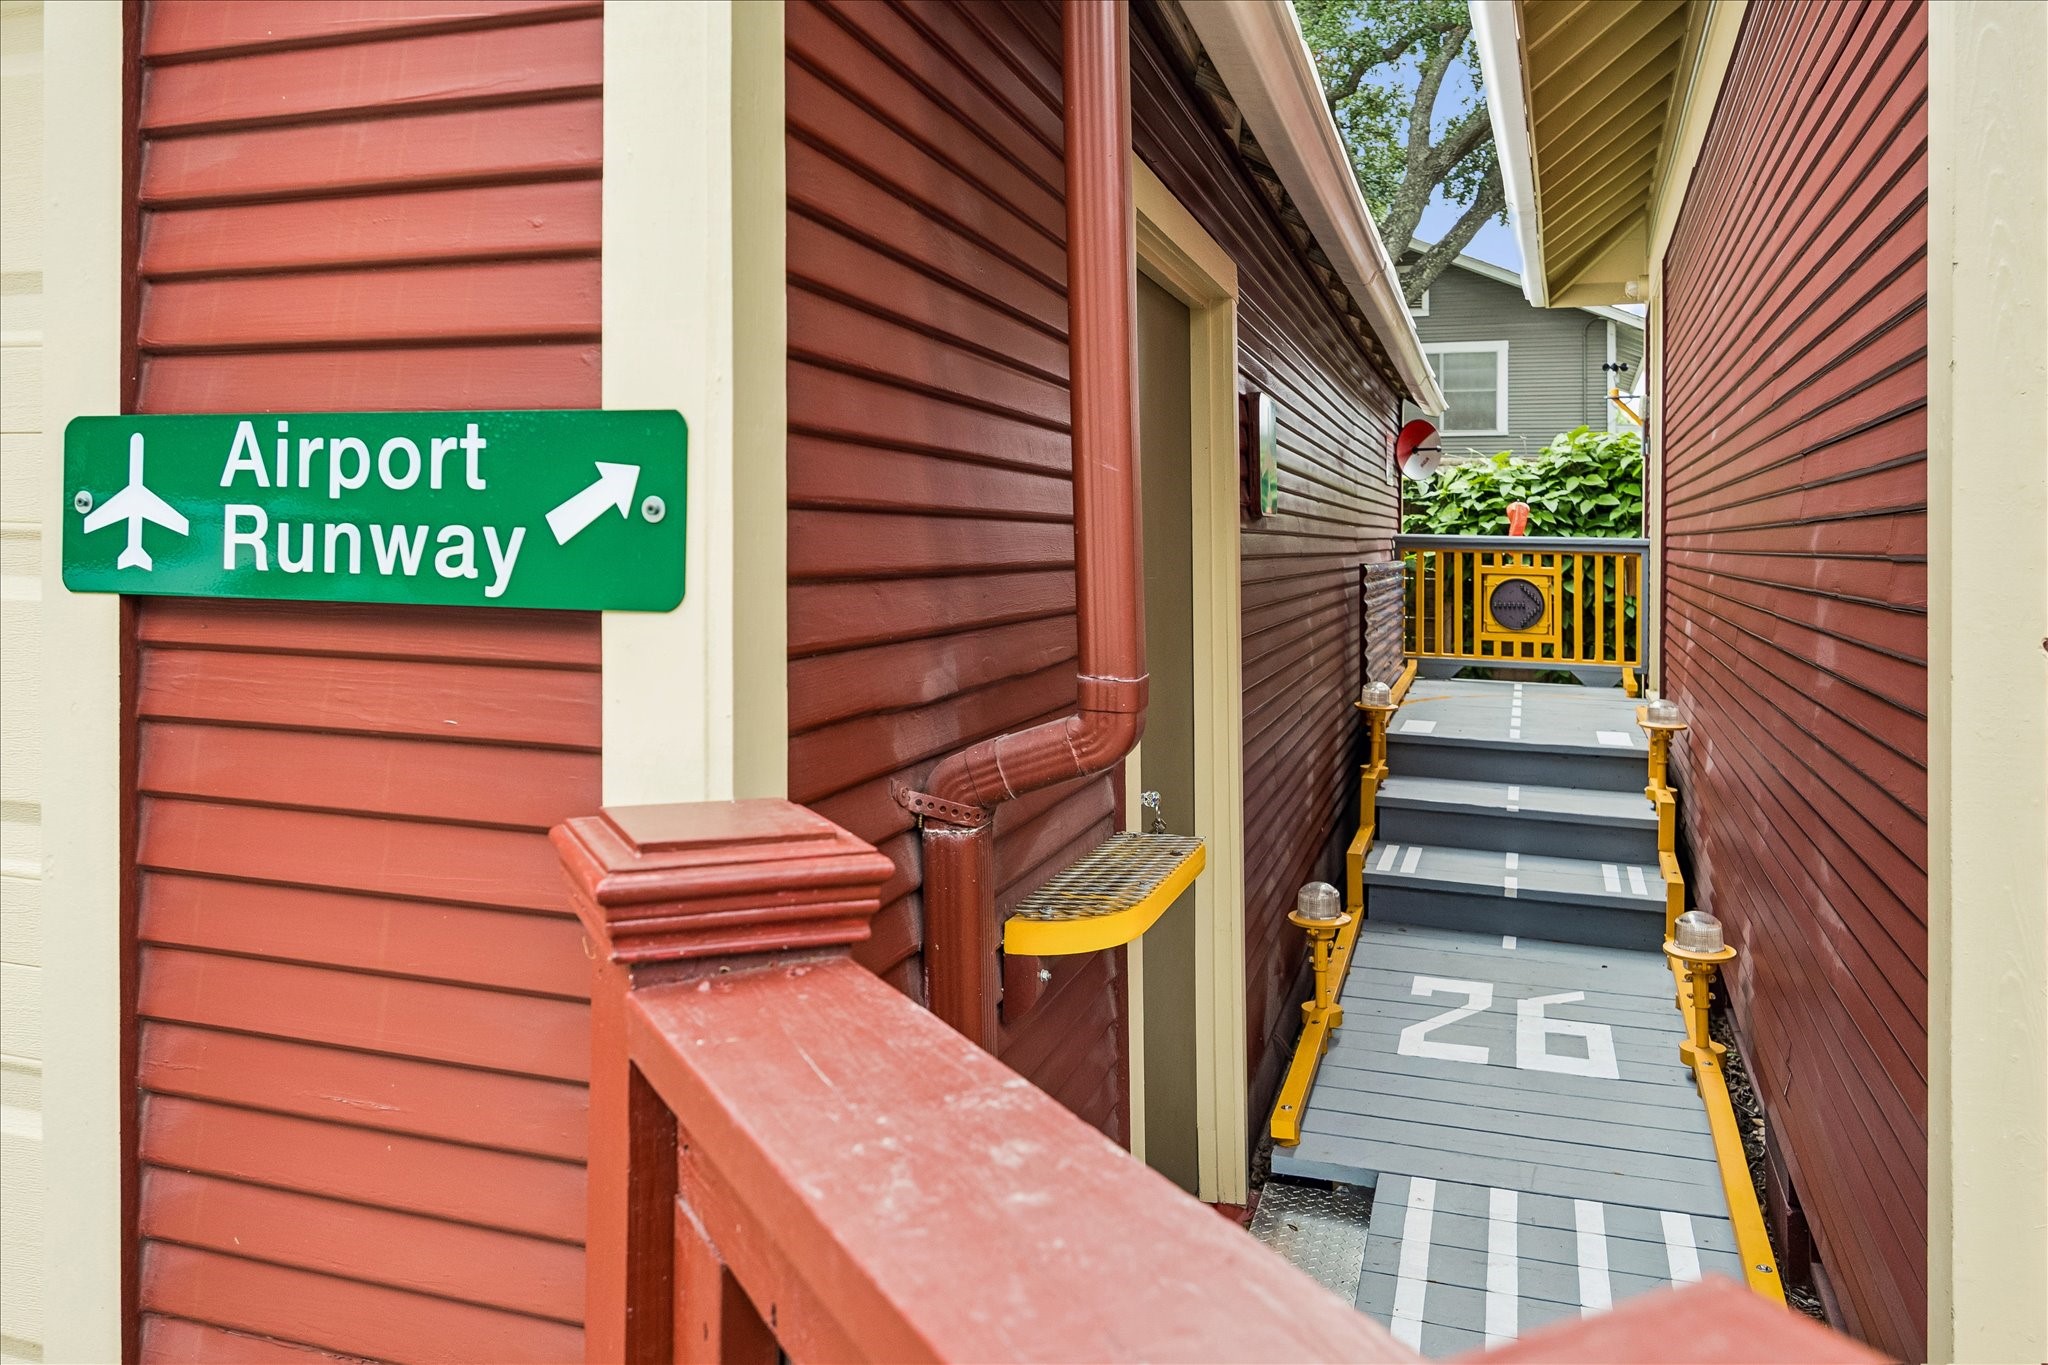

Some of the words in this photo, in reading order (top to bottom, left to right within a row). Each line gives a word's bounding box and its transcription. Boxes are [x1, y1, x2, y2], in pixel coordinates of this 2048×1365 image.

[219, 420, 487, 500] Airport
[222, 503, 527, 598] Runway
[1397, 975, 1620, 1079] 26
